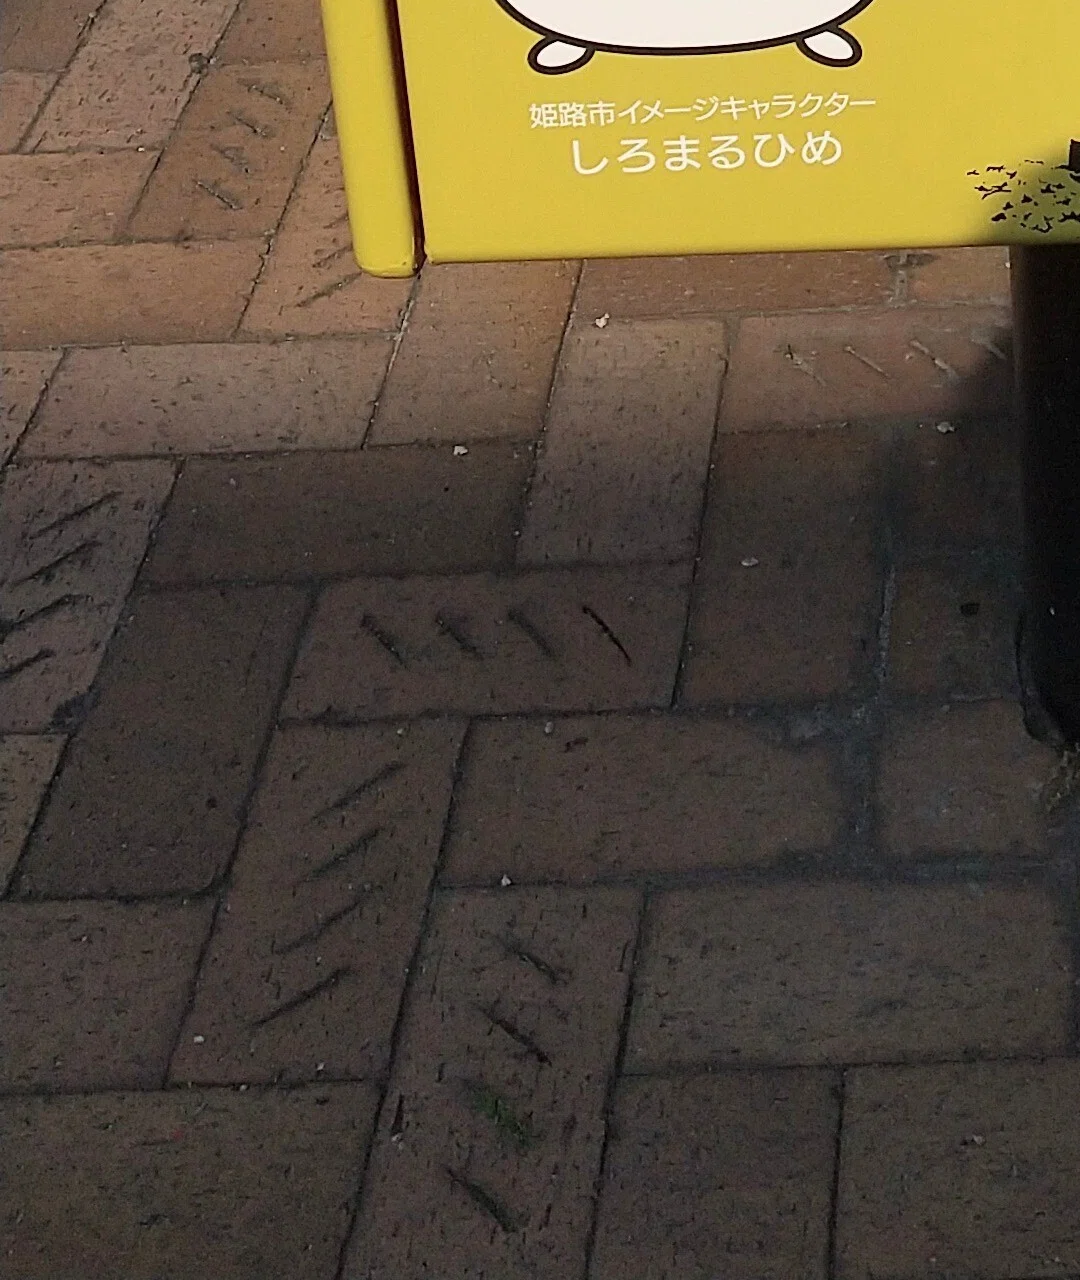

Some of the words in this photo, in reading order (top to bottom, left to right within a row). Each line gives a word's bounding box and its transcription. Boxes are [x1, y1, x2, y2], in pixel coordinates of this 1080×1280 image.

[528, 91, 877, 130] 姫路市イメージキャラクター
[571, 130, 844, 176] しろまるひめ
